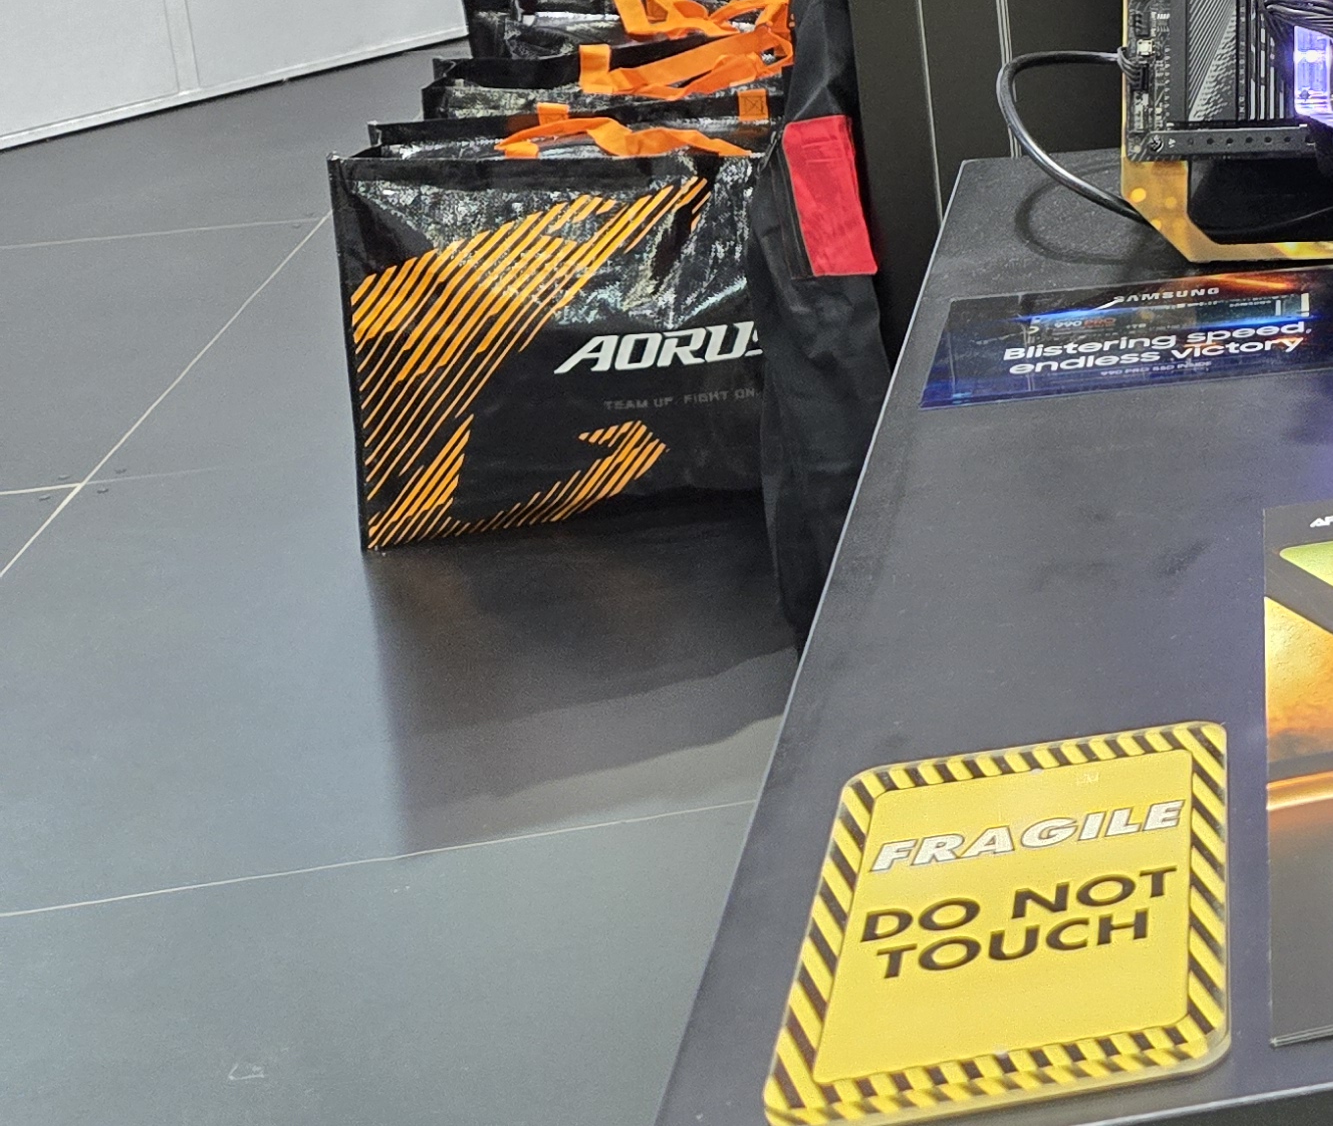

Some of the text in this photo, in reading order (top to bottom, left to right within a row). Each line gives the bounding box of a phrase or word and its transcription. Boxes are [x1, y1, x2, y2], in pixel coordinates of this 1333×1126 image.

[1115, 287, 1220, 302] SAMSUNG
[1003, 321, 1313, 361] Blistering speed.
[1009, 337, 1305, 376] endless victory
[604, 399, 648, 411] TEAM
[868, 798, 1186, 874] FRAGILE
[859, 865, 1178, 944] DO NOT
[876, 908, 1149, 980] TOUCH
